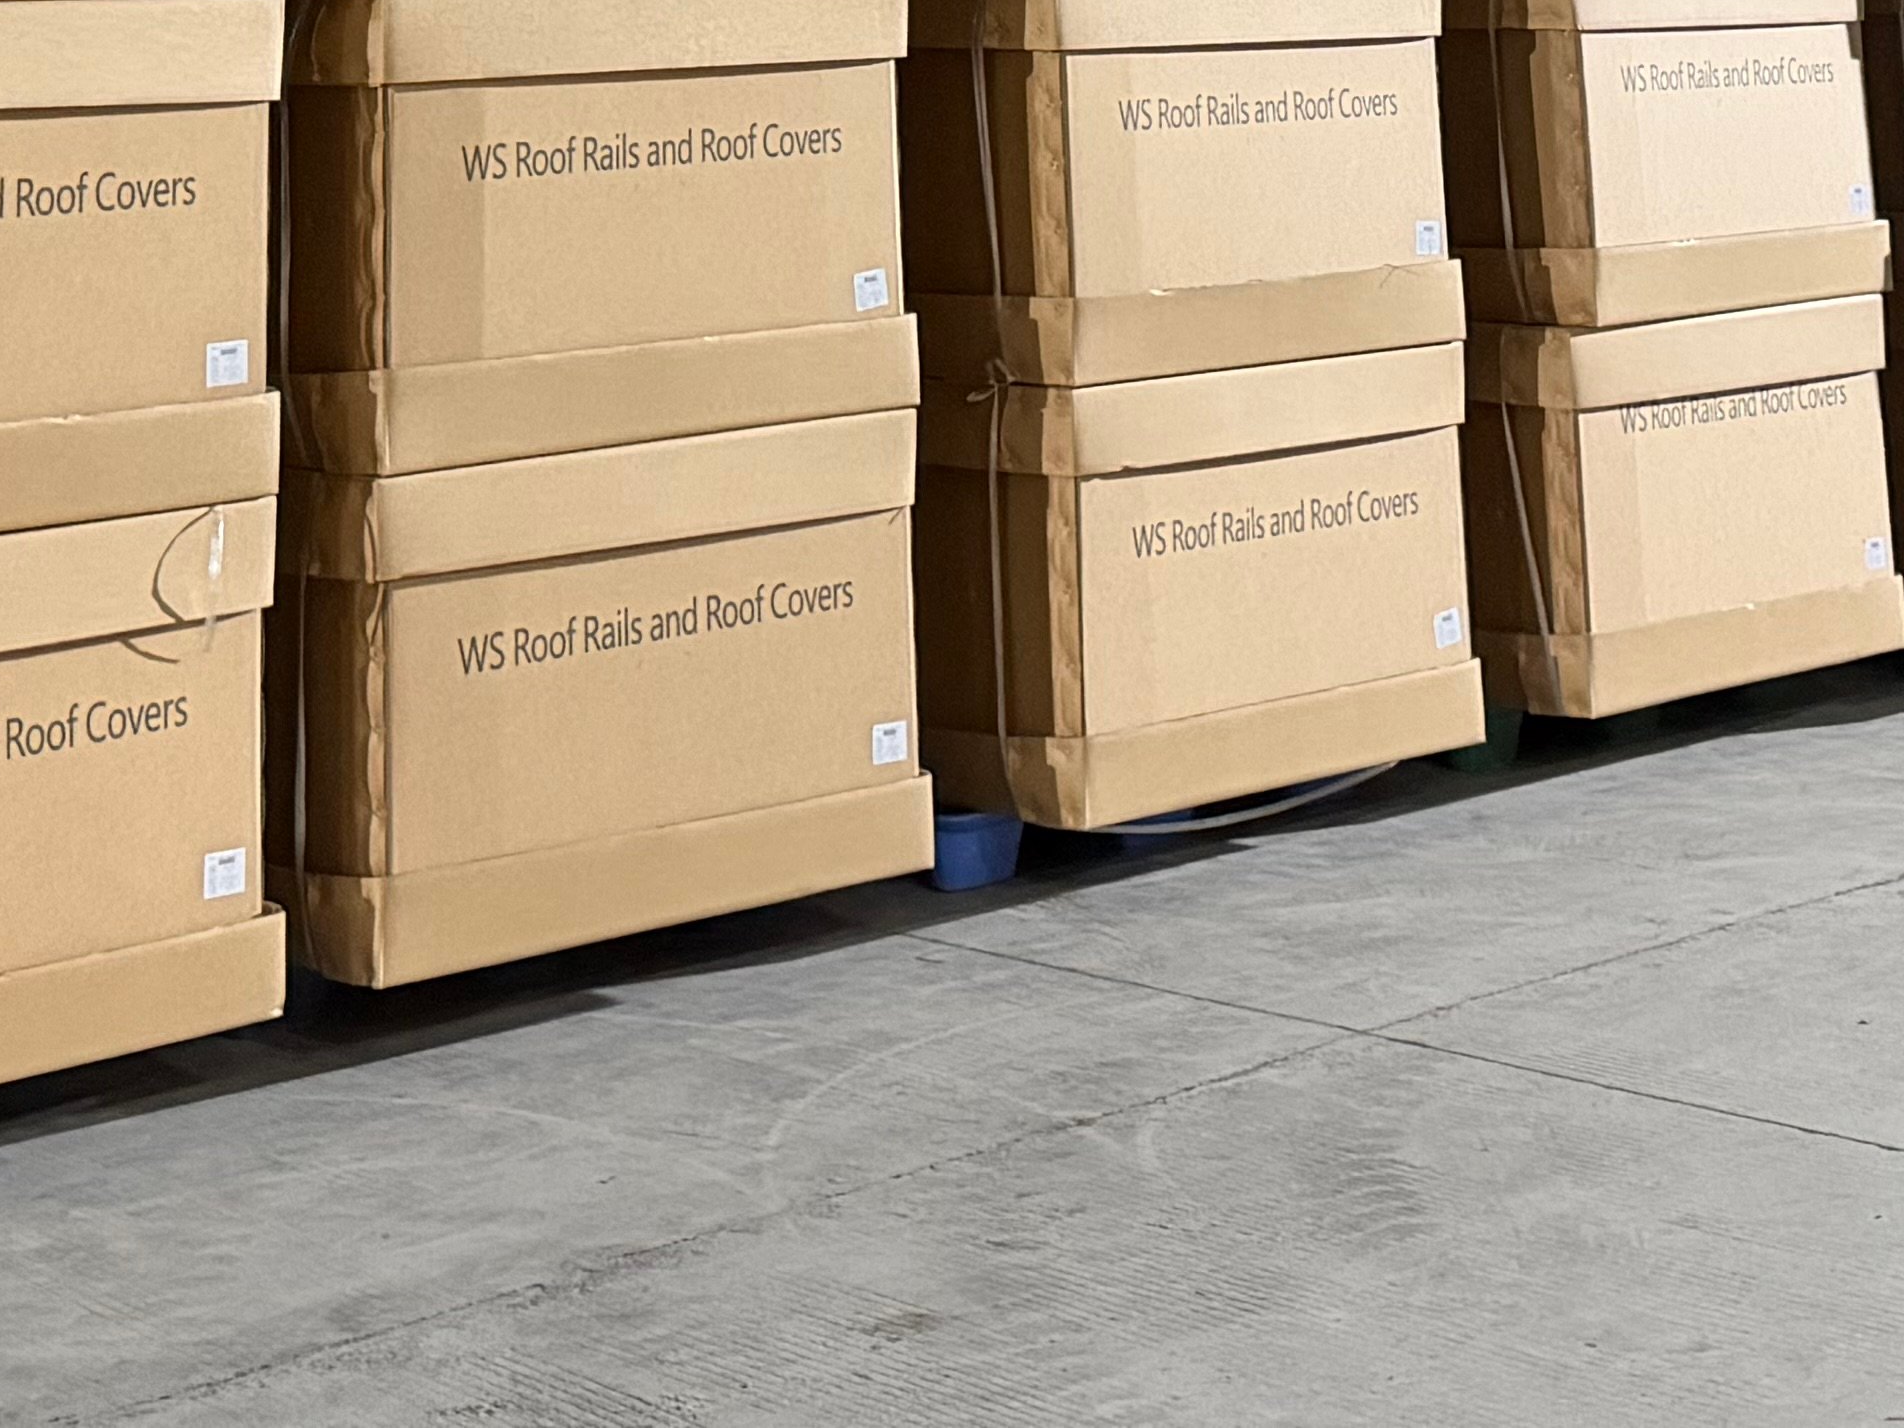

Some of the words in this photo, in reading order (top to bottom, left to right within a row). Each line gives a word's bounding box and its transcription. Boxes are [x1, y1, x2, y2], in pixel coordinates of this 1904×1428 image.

[1620, 64, 1647, 93] WS
[1650, 61, 1683, 91] Roof
[1687, 60, 1720, 89] Rails
[1723, 58, 1750, 87] and
[1753, 56, 1785, 86] Roof
[1788, 57, 1834, 84] Covers
[1118, 98, 1152, 131] WS
[1158, 94, 1202, 129] Roof
[1207, 93, 1250, 126] Rails
[1255, 91, 1288, 123] and
[1293, 88, 1334, 121] Roof
[1339, 88, 1398, 118] Covers
[462, 143, 507, 181] WS
[516, 136, 576, 178] Roof
[583, 133, 640, 171] Rails
[647, 128, 692, 167] and
[701, 123, 757, 162] Roof
[763, 123, 841, 158] Covers
[16, 171, 88, 218] Roof
[95, 172, 196, 211] Covers
[1132, 522, 1166, 558] WS
[1172, 512, 1217, 552] Roof
[1222, 507, 1265, 544] Rails
[1270, 499, 1305, 537] and
[1310, 491, 1353, 530] Roof
[1357, 490, 1419, 522] Covers
[458, 631, 505, 675] WS
[514, 616, 576, 666] Roof
[584, 607, 642, 653] Rails
[650, 596, 697, 641] and
[706, 584, 765, 631] Roof
[770, 581, 853, 619] Covers
[6, 703, 79, 760] Roof
[86, 696, 187, 743] Covers
